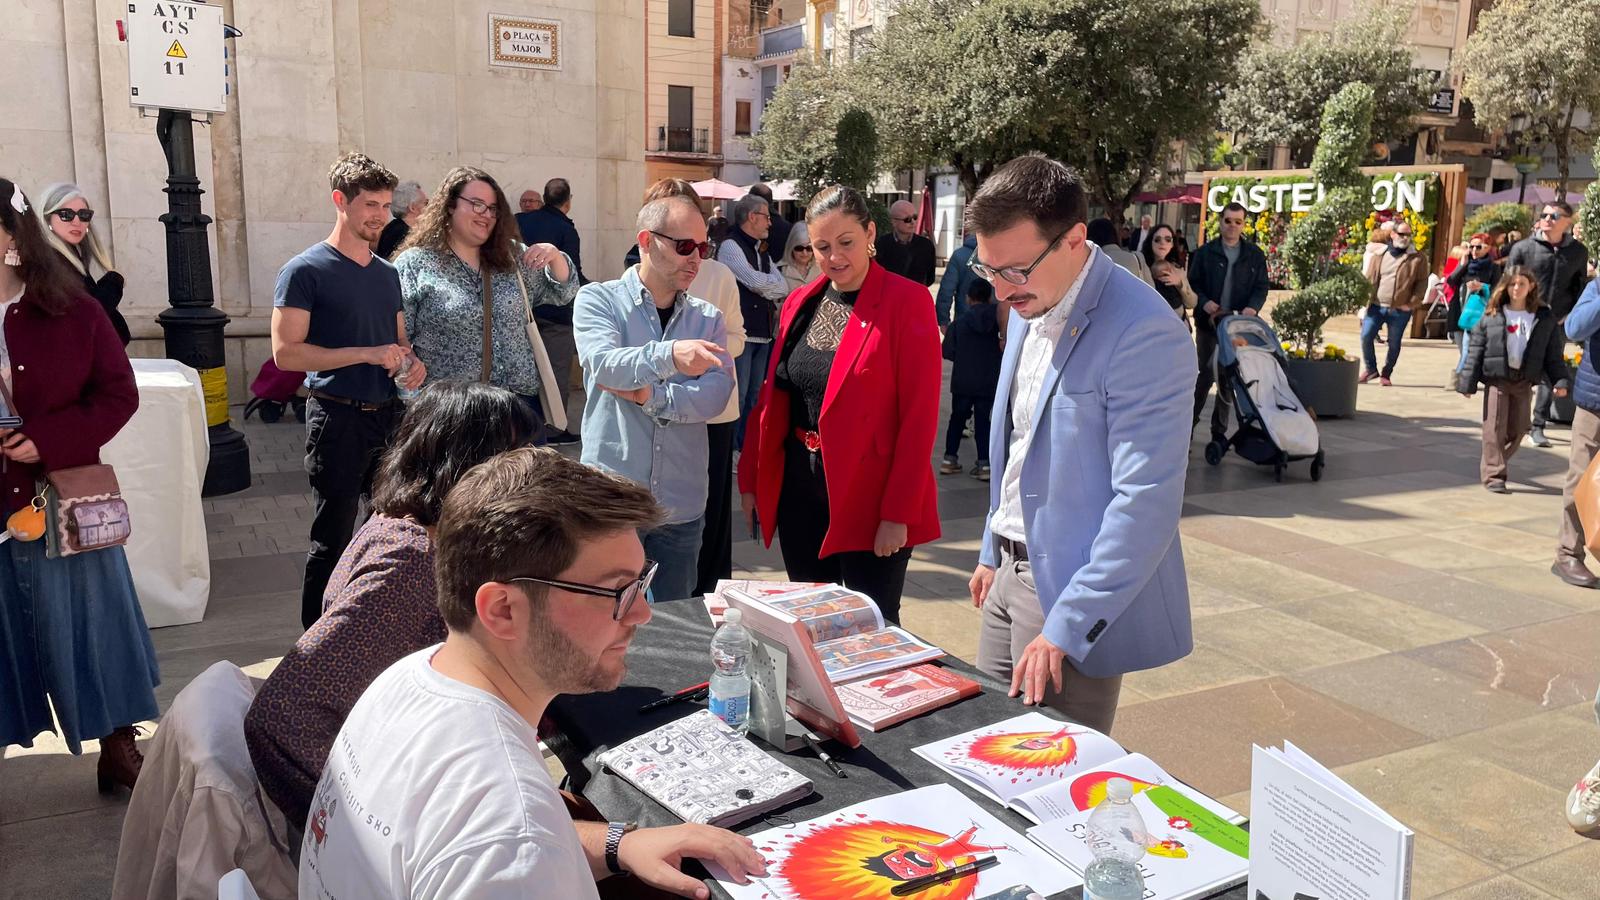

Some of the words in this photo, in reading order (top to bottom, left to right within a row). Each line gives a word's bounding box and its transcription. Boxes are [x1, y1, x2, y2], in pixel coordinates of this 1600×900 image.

[153, 3, 197, 20] AYT
[162, 20, 189, 35] CS
[513, 31, 541, 41] PLAÇA
[512, 44, 541, 54] MAJOR
[163, 61, 185, 75] 11
[1207, 172, 1426, 213] CASTEÓN
